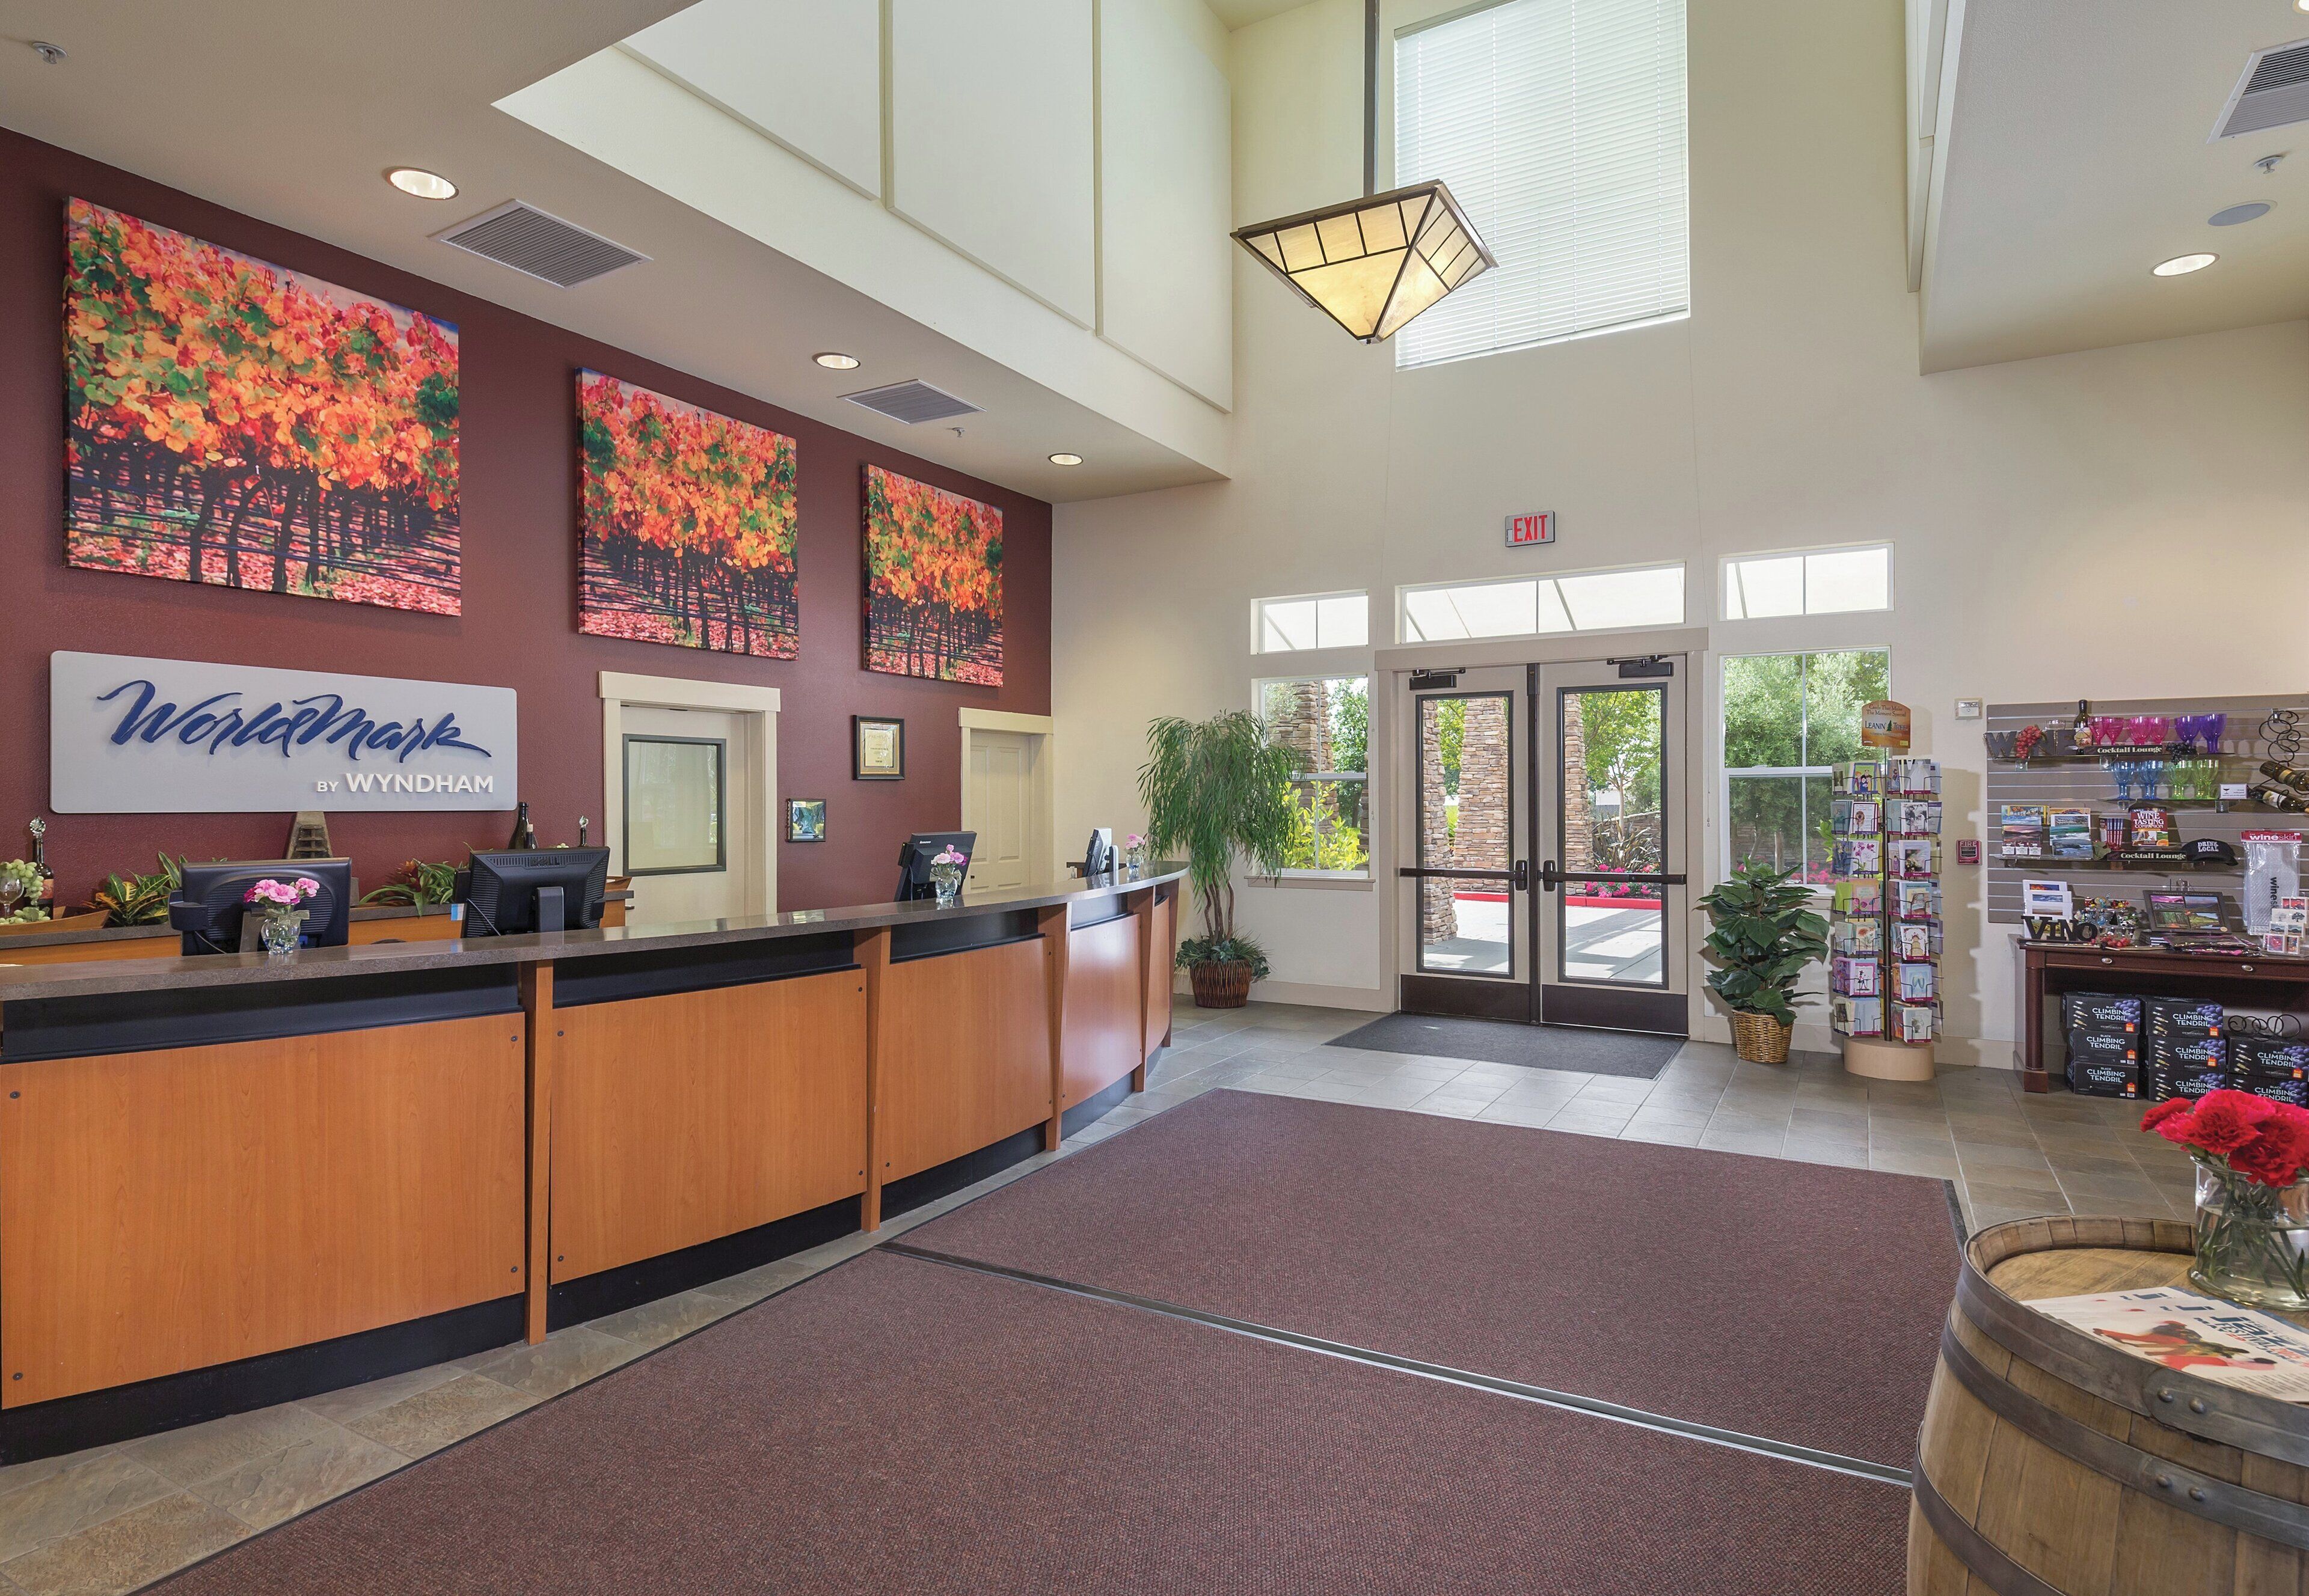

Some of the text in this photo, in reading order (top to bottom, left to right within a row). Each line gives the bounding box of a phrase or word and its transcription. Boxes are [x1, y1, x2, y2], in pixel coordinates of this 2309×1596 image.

[1513, 515, 1548, 542] EXIT
[97, 680, 492, 763] WorldMark
[1983, 730, 2078, 757] WNE
[317, 773, 493, 793] BY WYNDHAM
[2270, 877, 2280, 910] winesk
[2021, 916, 2097, 942] VINO
[2090, 1042, 2122, 1050] TENDRIL
[2257, 1053, 2299, 1062] CLIMBING
[2260, 1058, 2296, 1068] TENDRIL
[2087, 1069, 2126, 1077] CLIMBING
[2090, 1075, 2123, 1083] TENDRIL
[2254, 1087, 2297, 1096] CLIMBING
[2215, 1322, 2277, 1348] FESTIVAL
